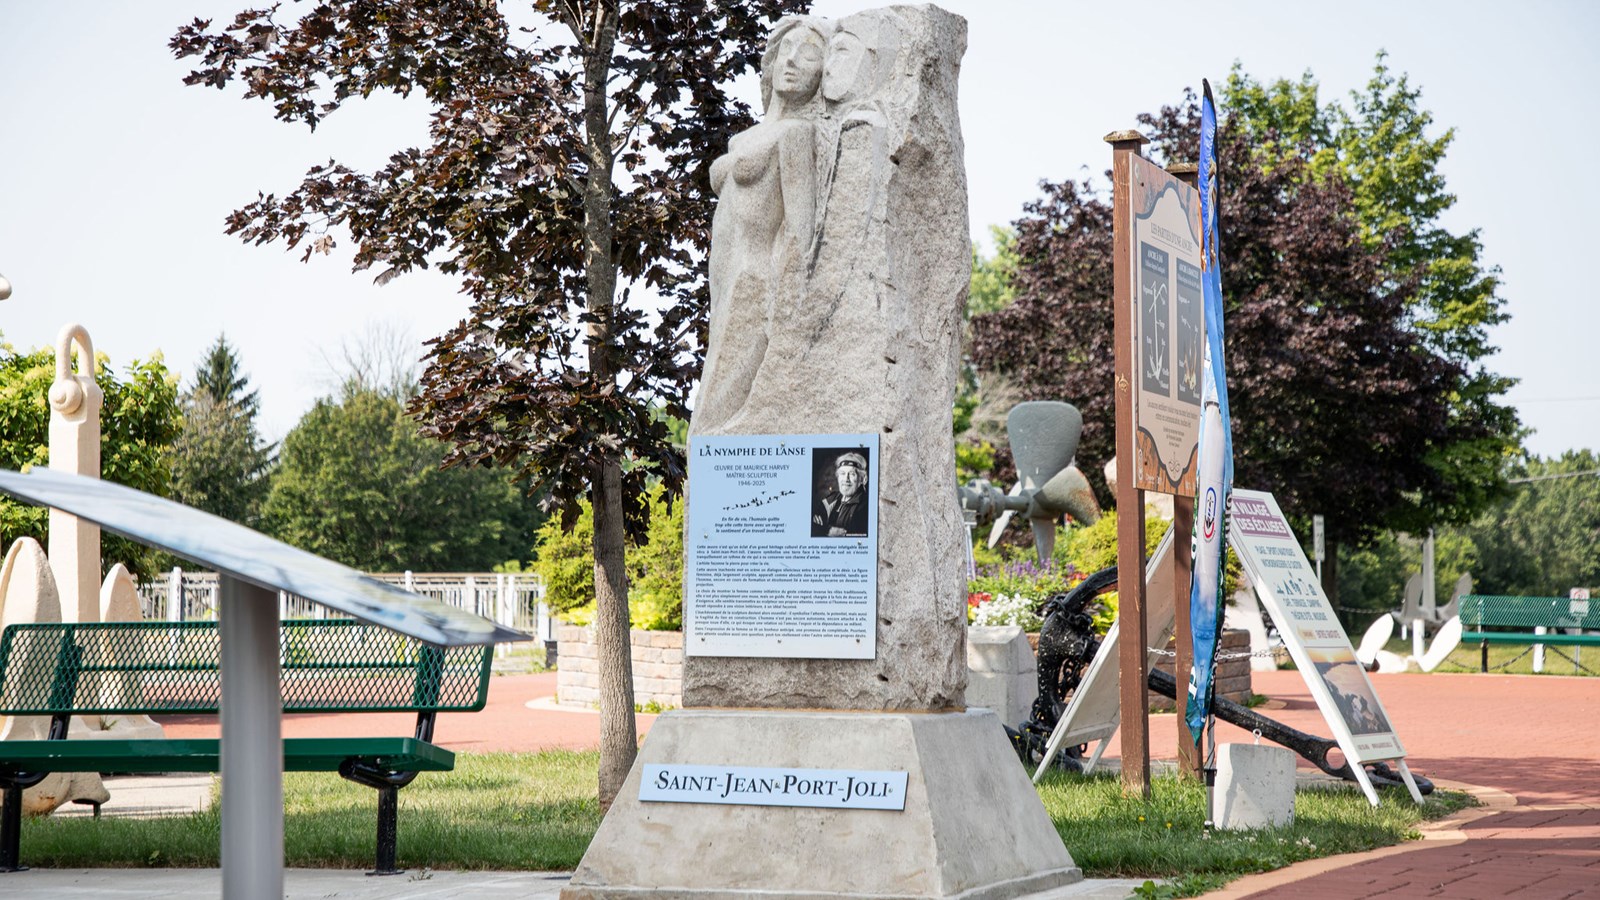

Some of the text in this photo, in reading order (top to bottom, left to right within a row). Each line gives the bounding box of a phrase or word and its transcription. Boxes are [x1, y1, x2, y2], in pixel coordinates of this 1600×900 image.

[700, 448, 806, 456] LA NYMPHE DE L'ANSE
[1236, 502, 1270, 516] VILLAGE
[1236, 516, 1286, 533] DES ÉCLUSES
[657, 770, 889, 802] SAINT-JEAN-PORT-JOLI
